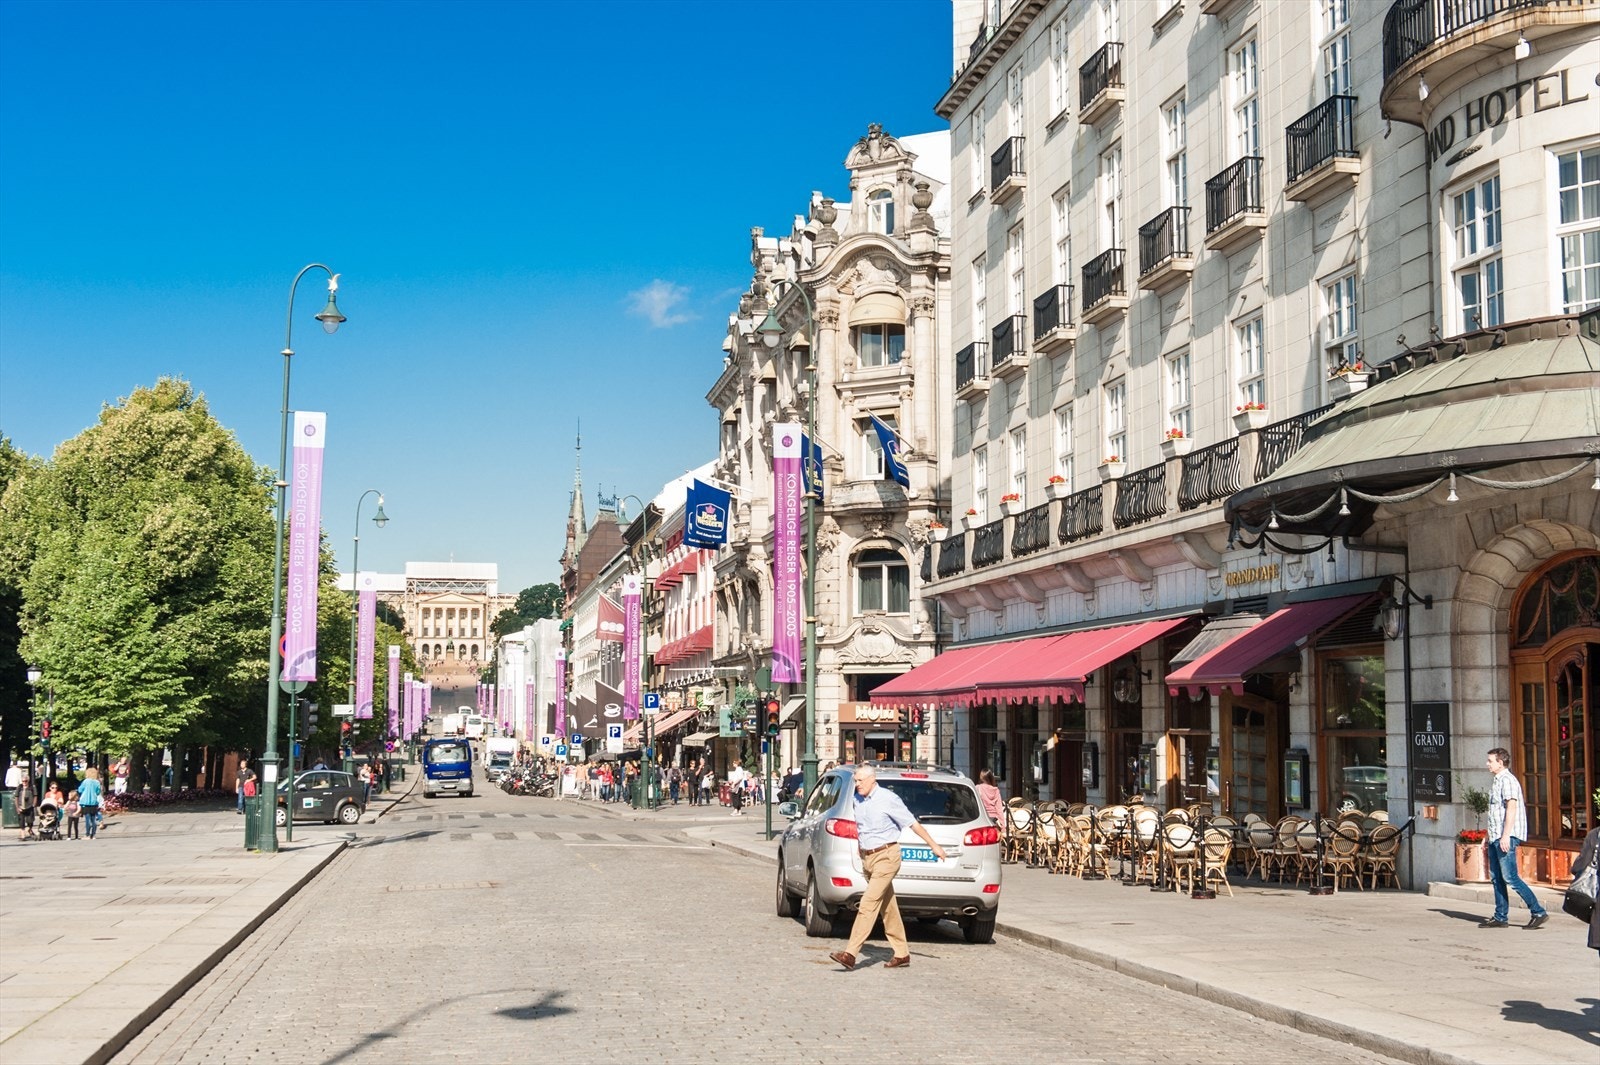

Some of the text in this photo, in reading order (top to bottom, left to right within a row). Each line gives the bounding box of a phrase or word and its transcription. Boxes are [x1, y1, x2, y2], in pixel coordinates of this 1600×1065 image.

[1466, 68, 1590, 139] HOTEL
[697, 515, 723, 528] Western
[702, 511, 717, 521] Best
[786, 473, 797, 637] KONGELIGE REISER 1905-2005
[1225, 567, 1256, 587] GRAND
[647, 695, 656, 707] P
[611, 727, 619, 737] P
[825, 727, 833, 735] 33
[1414, 734, 1445, 746] GRAND
[558, 746, 565, 754] P
